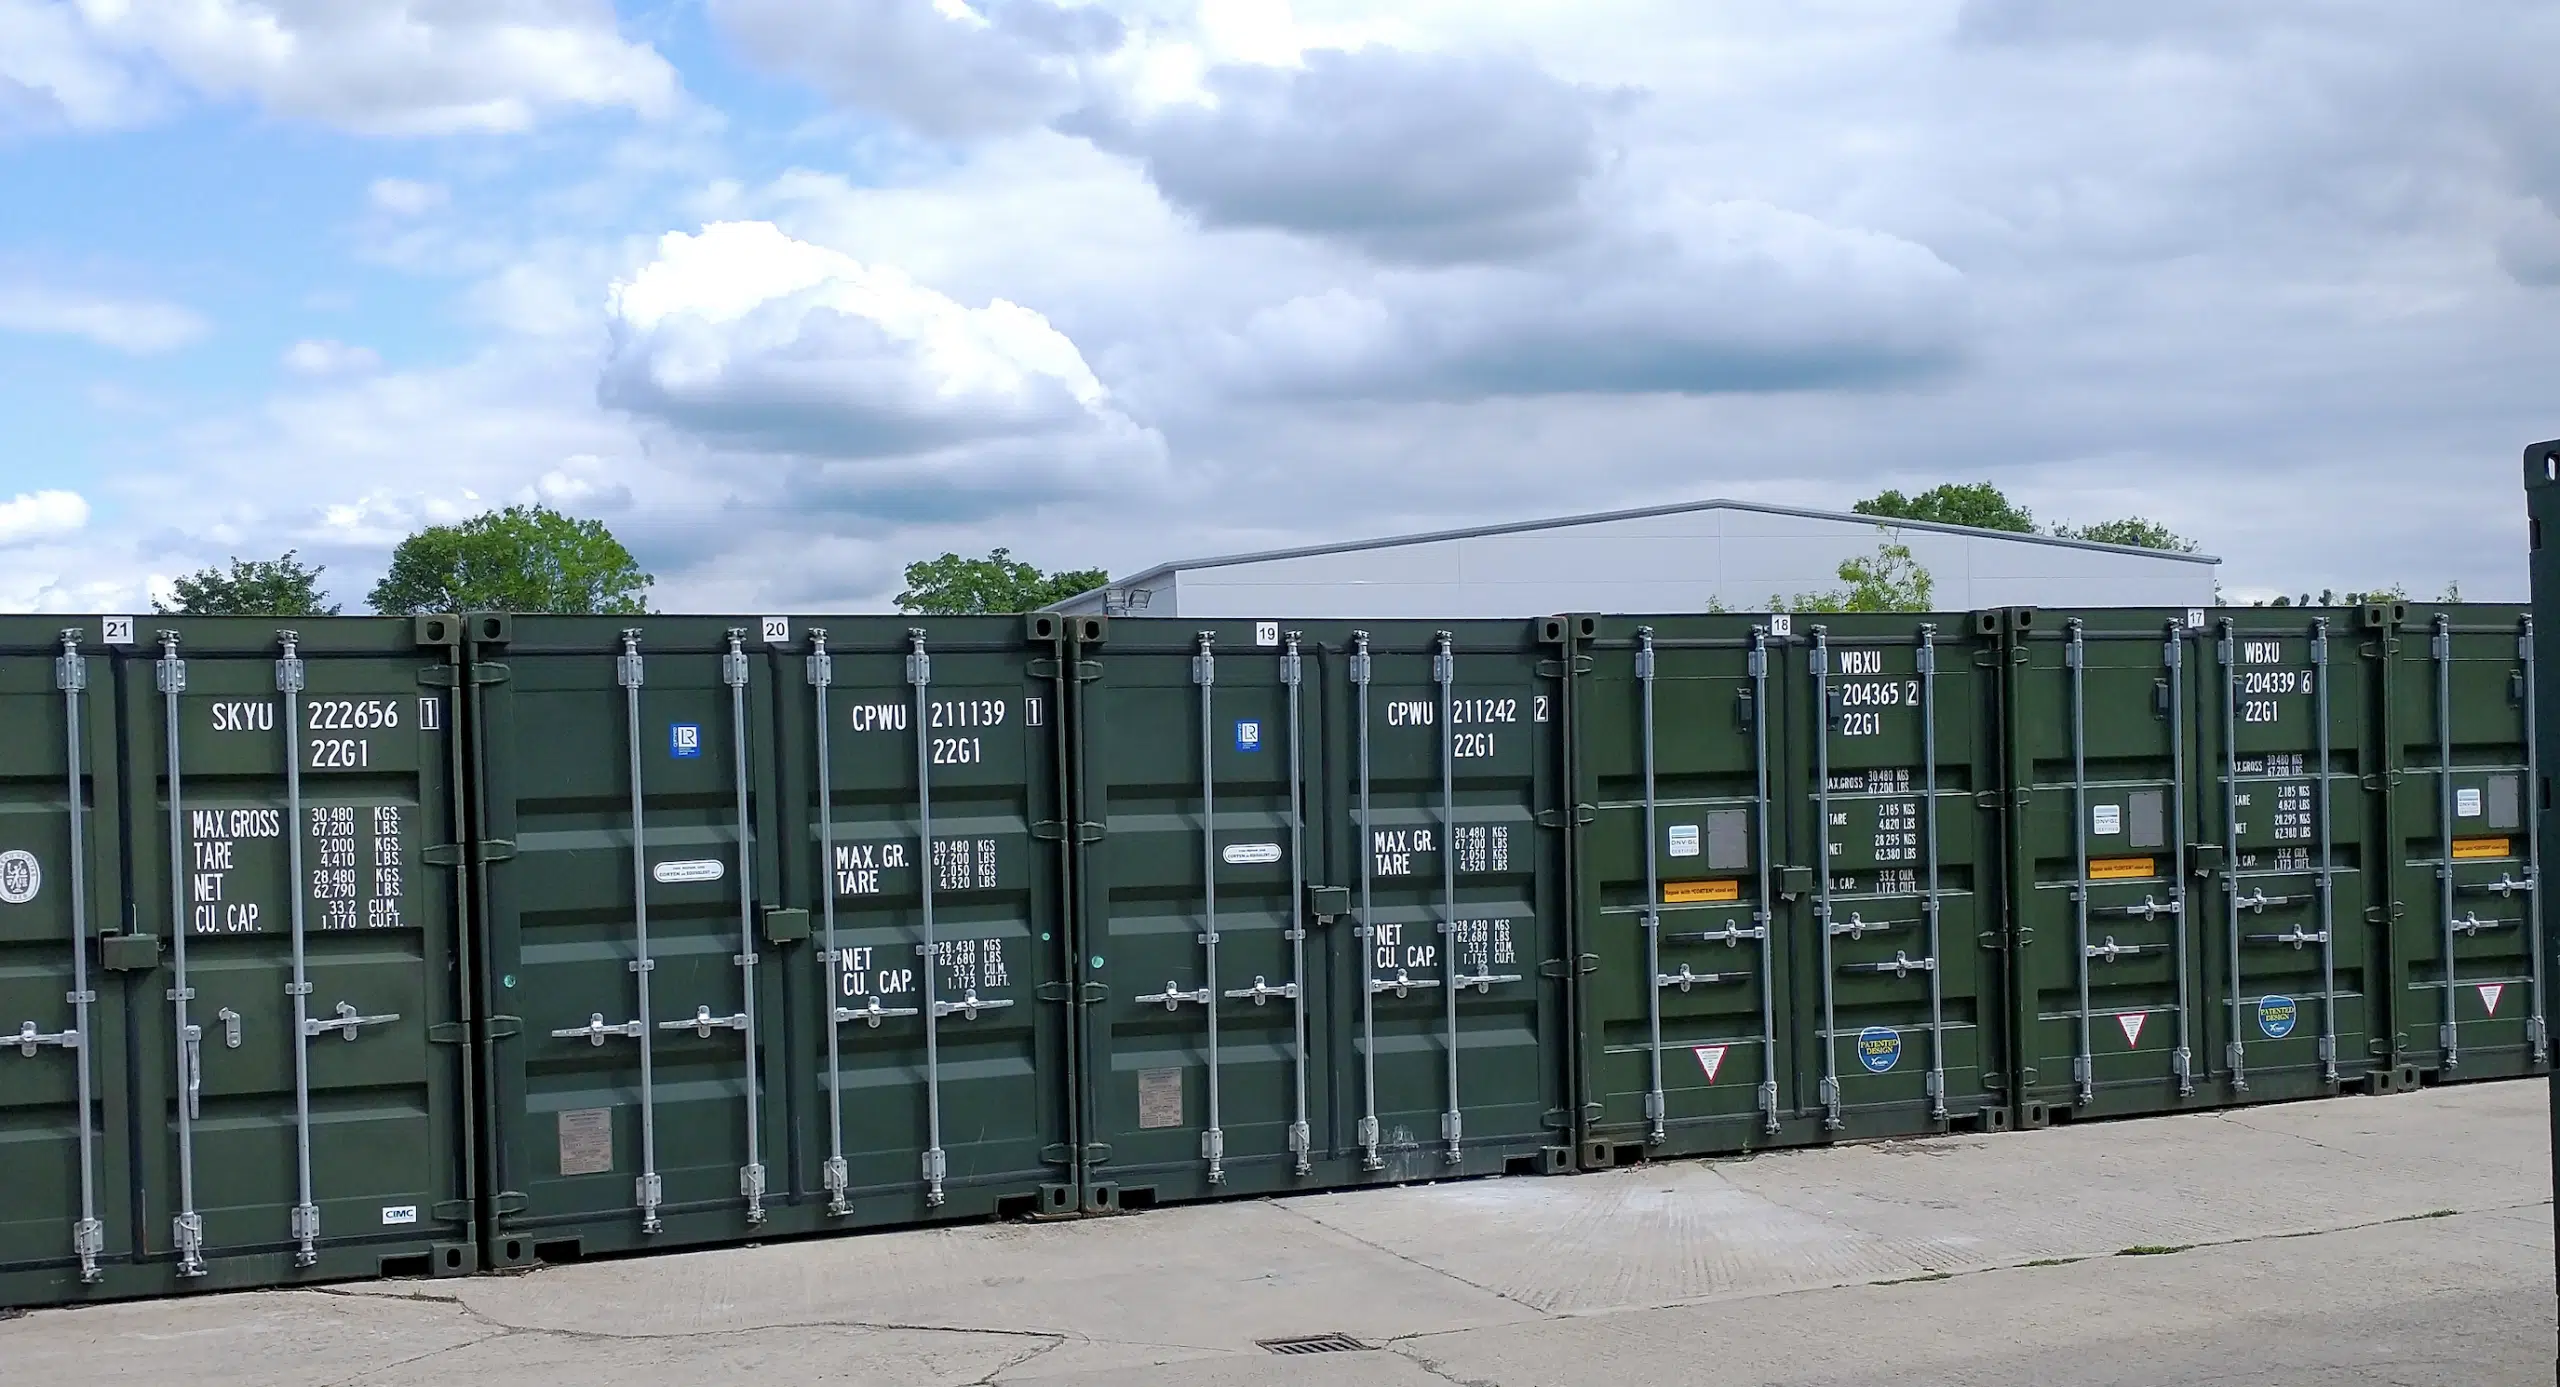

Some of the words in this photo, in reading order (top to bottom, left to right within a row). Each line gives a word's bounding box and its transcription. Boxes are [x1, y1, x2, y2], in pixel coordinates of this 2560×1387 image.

[766, 622, 786, 636] 20
[1774, 618, 1788, 630] 18
[2190, 612, 2202, 624] 17
[106, 624, 128, 638] 21
[1260, 628, 1276, 642] 19
[1840, 650, 1880, 674] WBXU
[2244, 642, 2280, 664] WBXU
[1842, 682, 1898, 706] 204365
[2245, 672, 2295, 694] 204339
[212, 702, 274, 731] SKYU
[308, 701, 398, 730] 222656
[852, 704, 906, 732] CPWU
[932, 700, 1006, 728] 211139
[1388, 701, 1434, 726] CPWU
[1453, 698, 1516, 724] 211242
[2246, 700, 2278, 722] 22G1
[1843, 712, 1880, 736] 22G1
[310, 740, 368, 768] 22G1
[932, 737, 980, 764] 22G1
[1454, 732, 1494, 758] 22G1
[374, 806, 402, 820] KGS.
[1829, 812, 1848, 826] TARE
[1492, 826, 1508, 838] KGS
[193, 842, 234, 870] TARE
[374, 836, 402, 852] KGS.
[977, 840, 996, 852] KGS
[1492, 838, 1508, 849] LBS
[1829, 842, 1842, 856] NET
[978, 852, 996, 864] LBS
[1375, 853, 1410, 876] TARE
[1492, 849, 1508, 860] KGS
[1492, 860, 1508, 871] LBS
[194, 873, 224, 902] NET
[375, 868, 402, 882] KGS.
[836, 870, 880, 894] TARE
[978, 863, 996, 876] KGS
[978, 876, 996, 888] LBS
[1840, 877, 1857, 890] CAP.
[195, 904, 220, 933] CU.
[226, 903, 262, 932] CAP.
[329, 900, 356, 915] 33.2
[1376, 924, 1403, 946] NET
[1494, 919, 1510, 931] KGS
[1494, 930, 1510, 942] LBS
[842, 946, 872, 972] NET
[983, 938, 1002, 952] KGS
[984, 951, 1002, 964] LBS
[1376, 946, 1399, 969] CU.
[1407, 946, 1438, 968] CAP.
[1468, 942, 1488, 954] 33.2
[843, 972, 870, 996] CU.
[879, 968, 916, 994] CAP.
[953, 964, 976, 978] 33.2
[1860, 1039, 1898, 1048] PATENTED
[1866, 1046, 1893, 1055] DESIGN
[386, 1209, 414, 1218] CIMC
